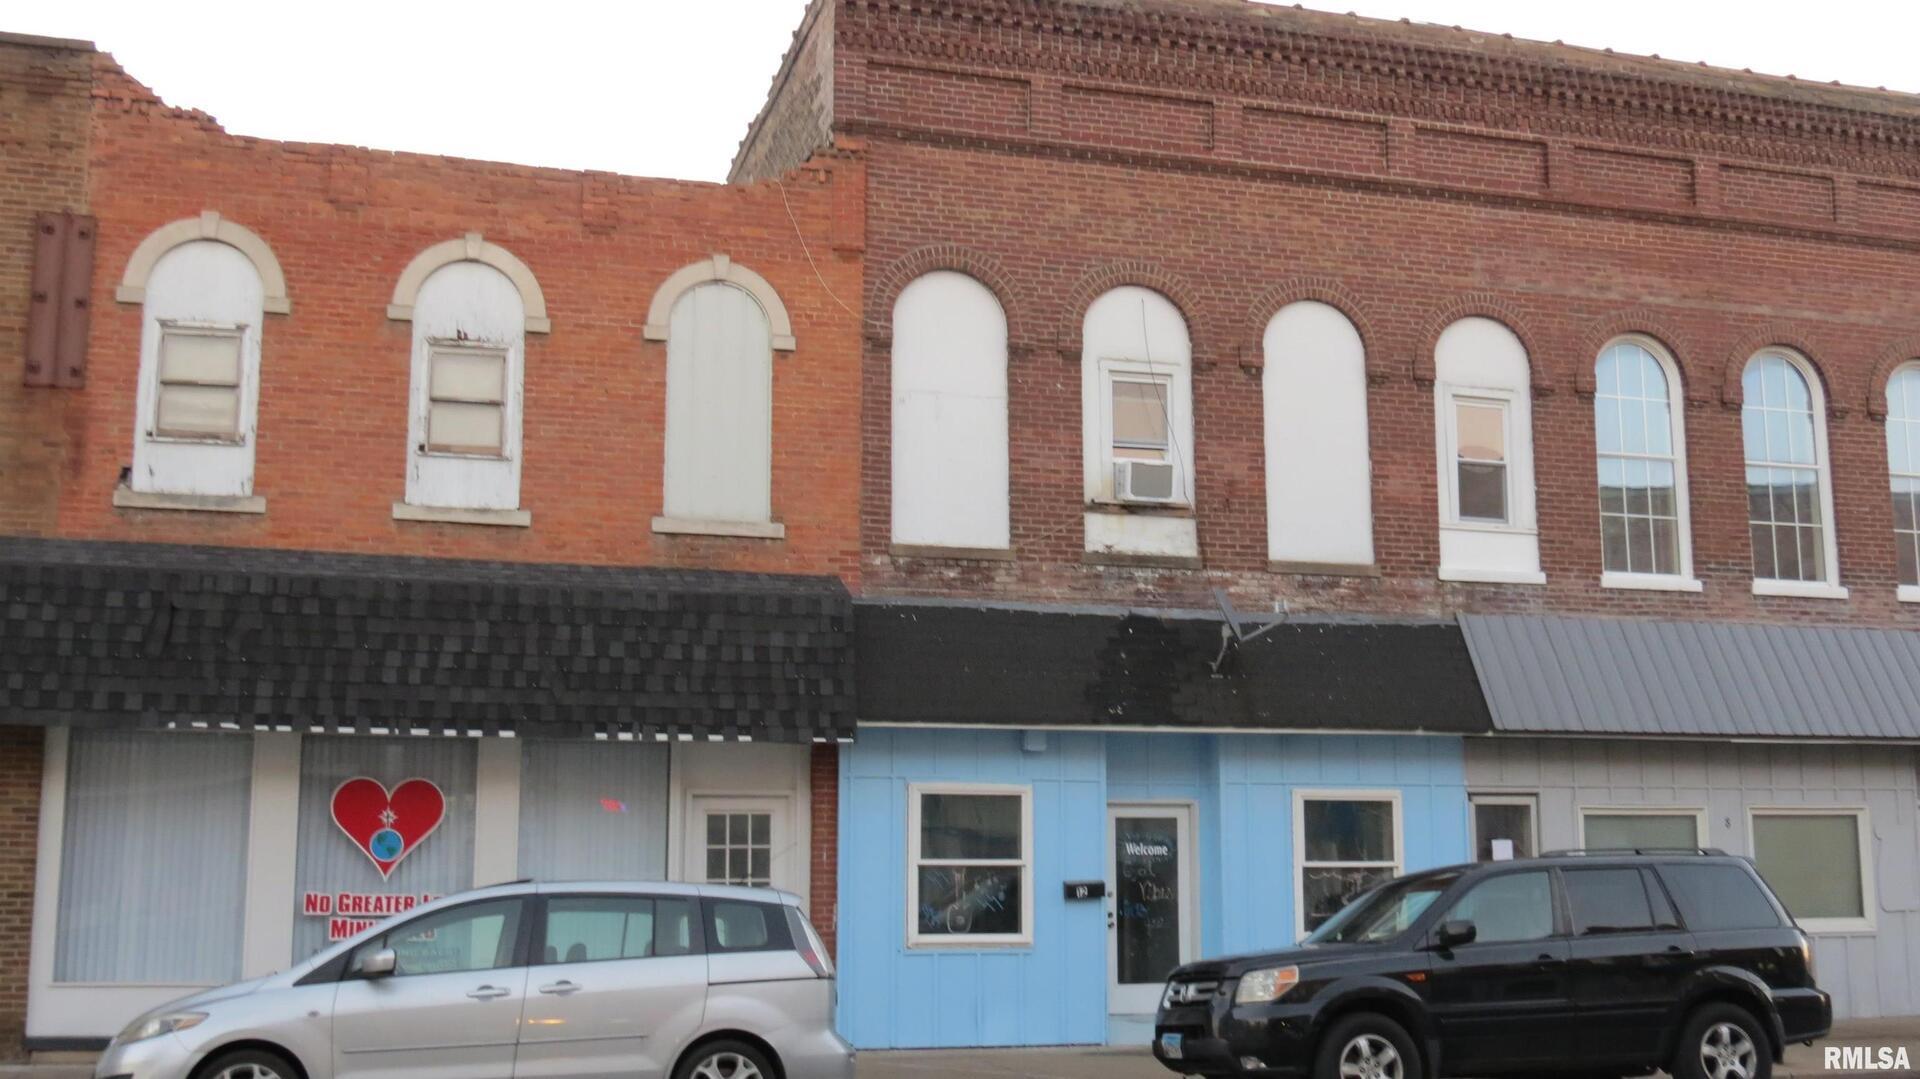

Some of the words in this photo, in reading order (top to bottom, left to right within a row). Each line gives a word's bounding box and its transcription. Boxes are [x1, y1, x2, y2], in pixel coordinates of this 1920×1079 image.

[1125, 842, 1168, 856] Welcome
[305, 894, 331, 913] NO
[338, 894, 416, 913] GREATER
